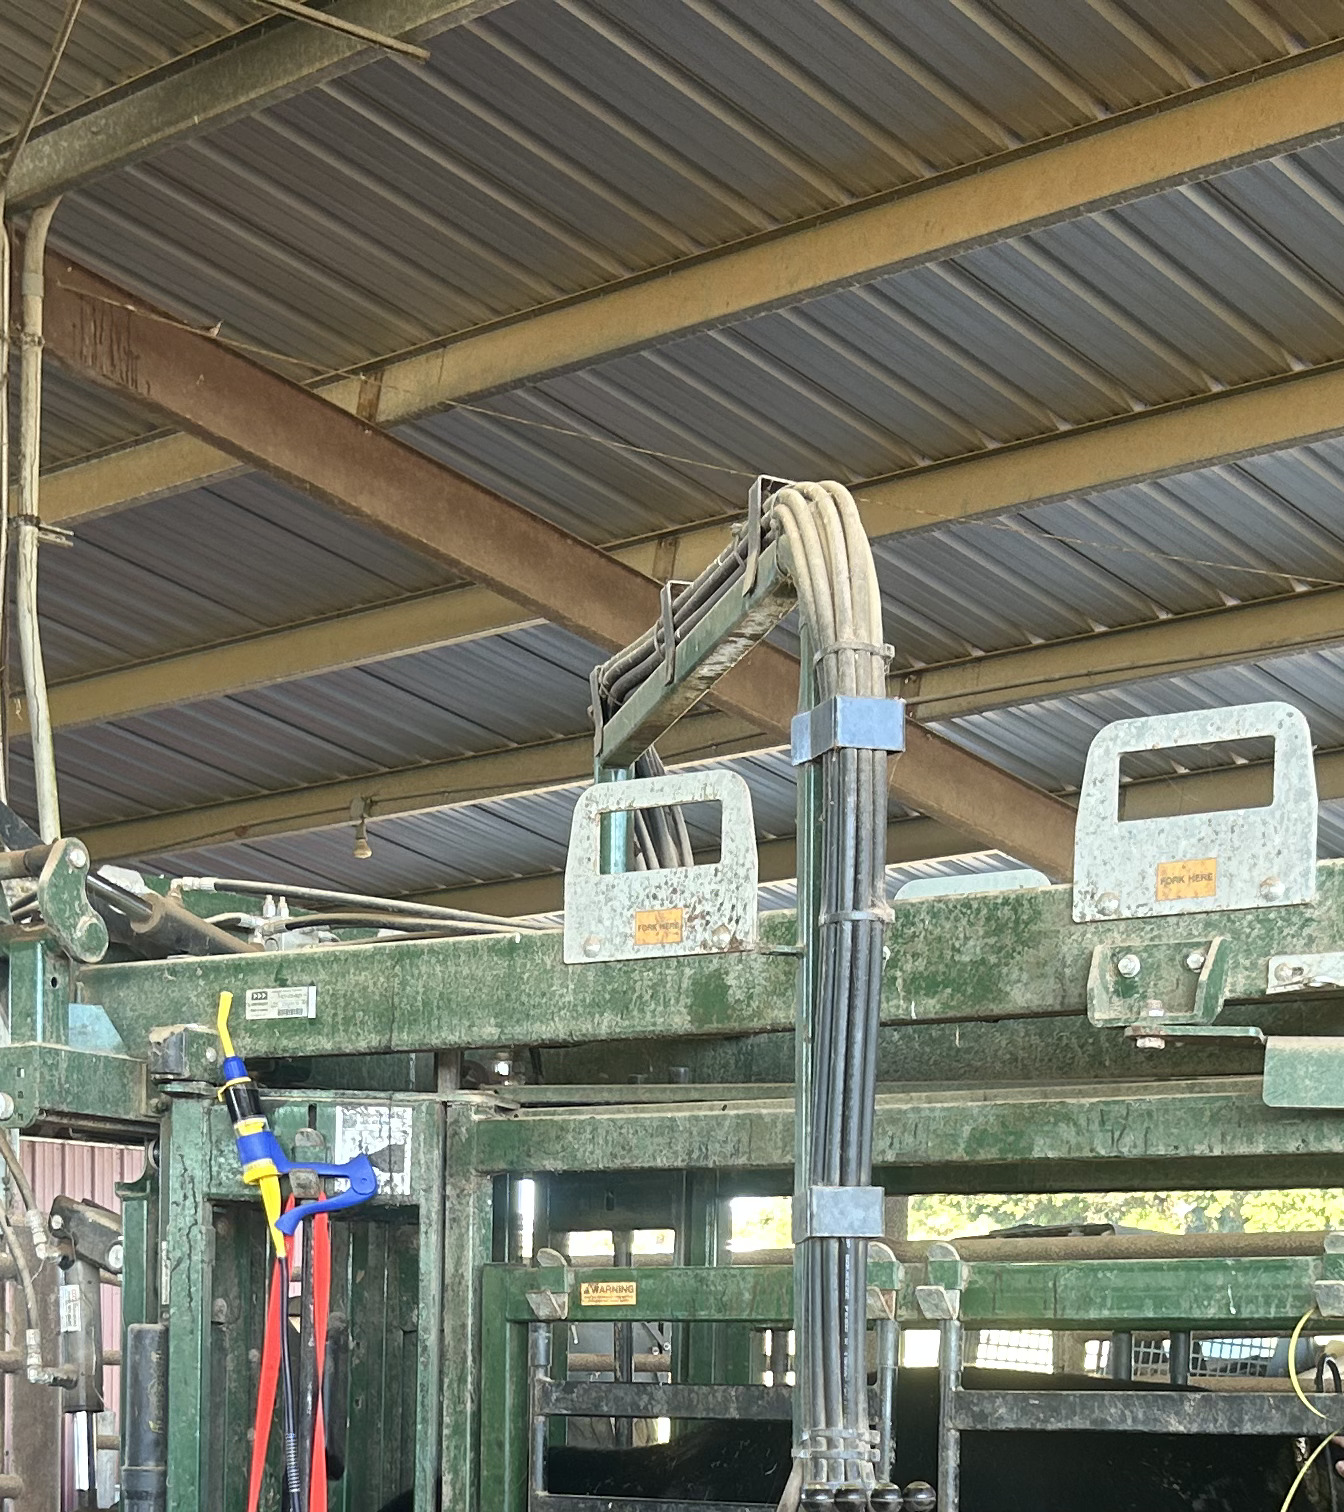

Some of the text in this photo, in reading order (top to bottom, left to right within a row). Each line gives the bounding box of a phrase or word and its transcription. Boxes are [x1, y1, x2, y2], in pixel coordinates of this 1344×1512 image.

[1160, 872, 1213, 884] FORK HERE
[592, 1284, 634, 1293] WARNING
